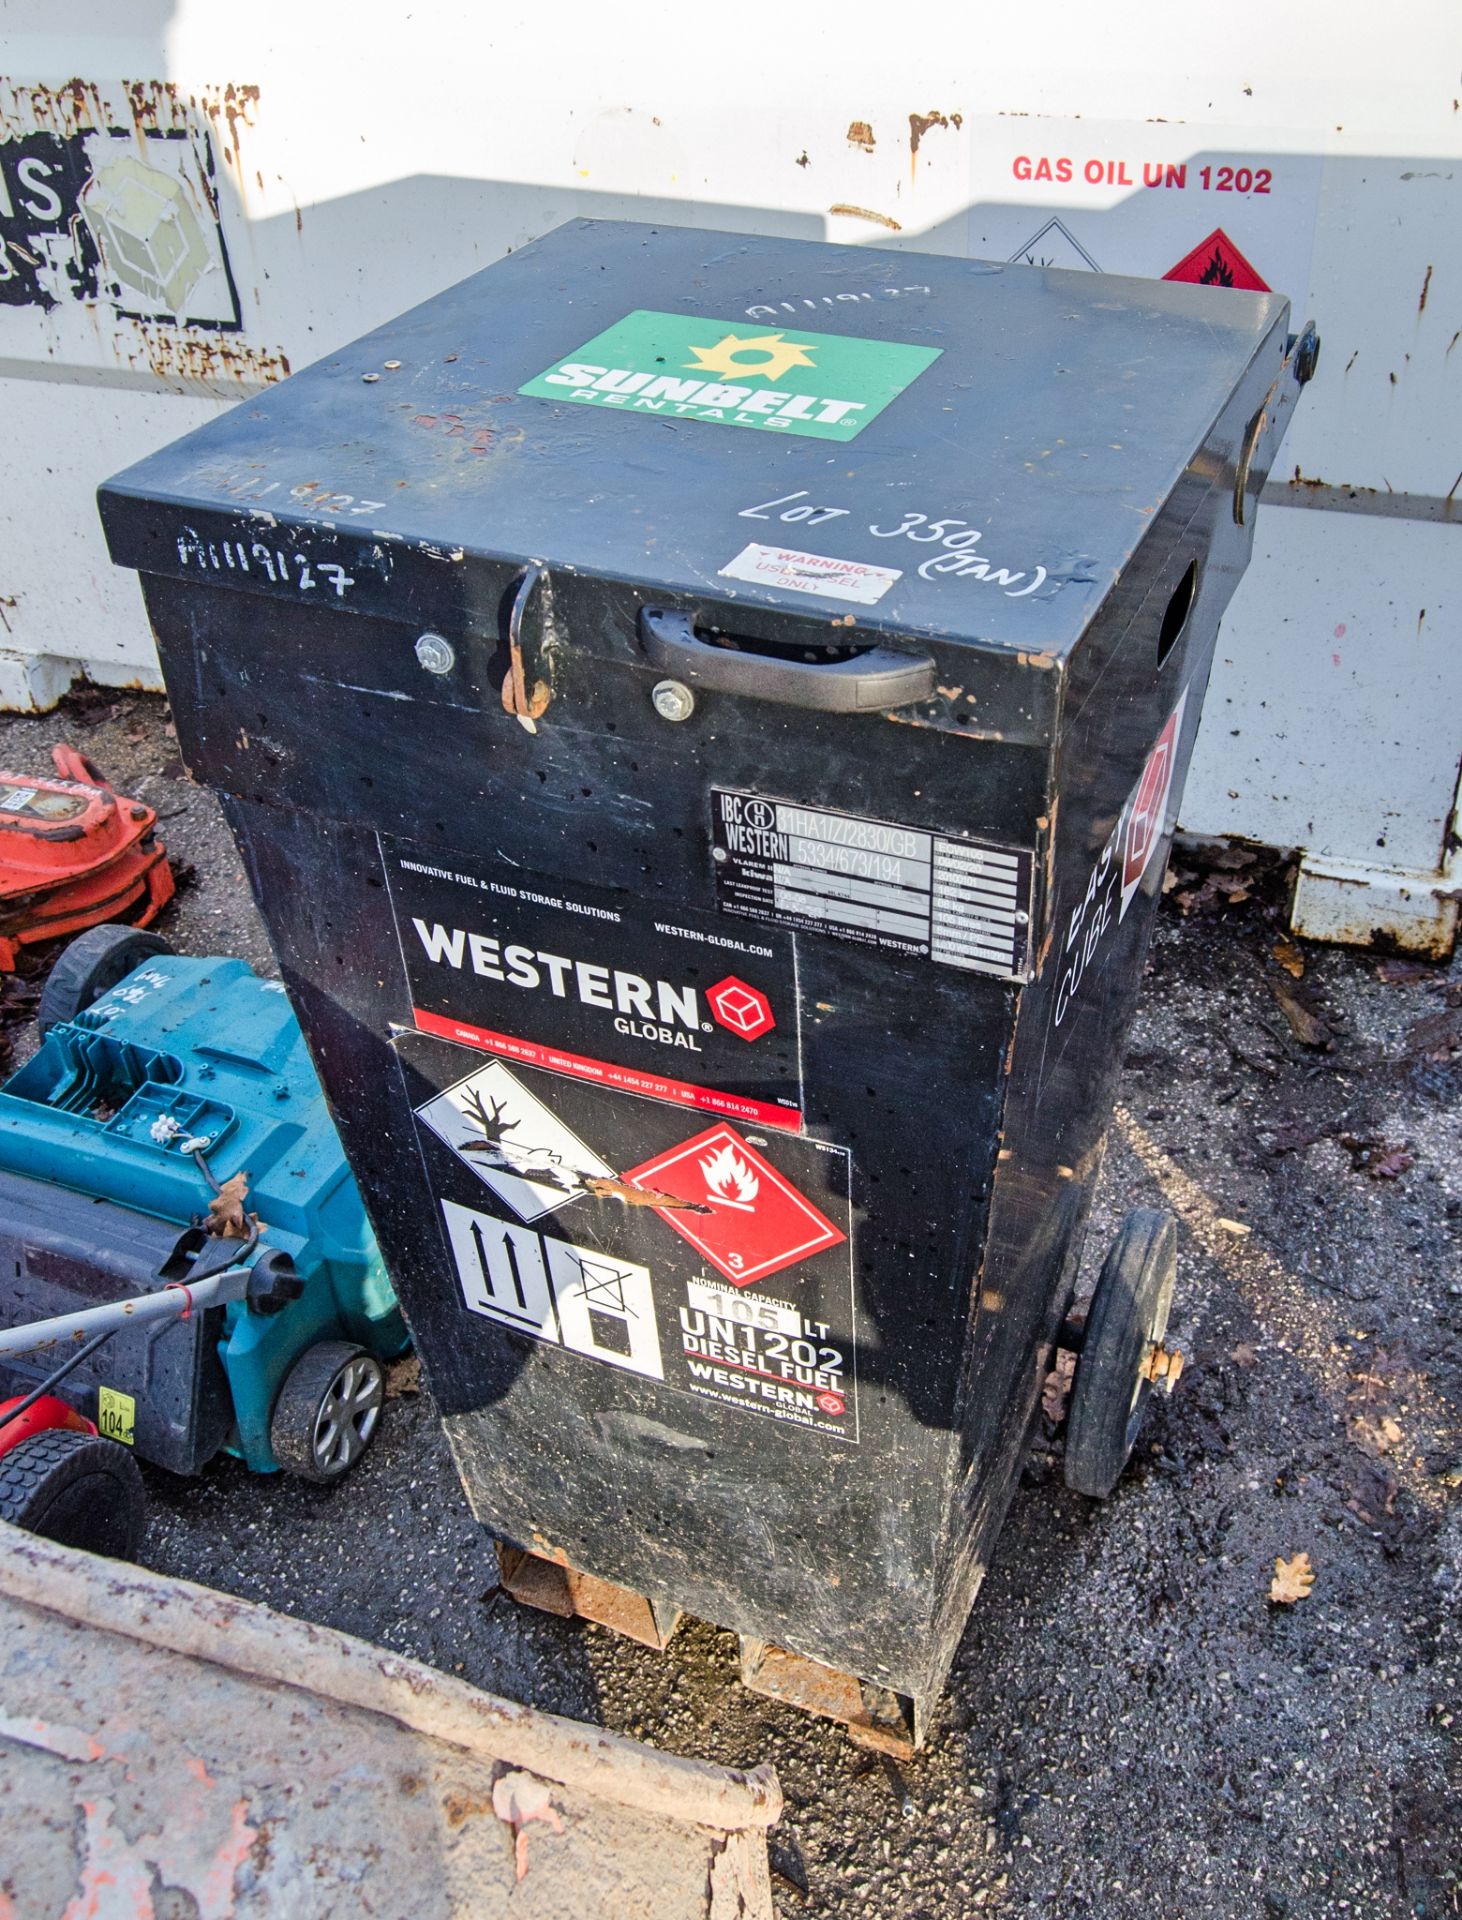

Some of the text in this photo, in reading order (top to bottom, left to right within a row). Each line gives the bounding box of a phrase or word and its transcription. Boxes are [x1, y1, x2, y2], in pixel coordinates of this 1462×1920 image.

[0, 157, 62, 221] S
[1012, 155, 1273, 194] GAS OIL UN 1202
[569, 389, 794, 428] RENTALS
[869, 513, 982, 549] 350
[777, 552, 870, 575] WARNING
[776, 577, 819, 592] ONLY
[721, 794, 742, 824] IBC
[724, 822, 788, 861] WESTERN
[733, 857, 766, 870] VLAREM
[742, 868, 773, 882] kiwa
[400, 860, 621, 922] INNOVATIVE FUEL & FLUID STORAGE SOLUTIONS
[654, 922, 773, 958] WESTERN-GLOBAL.COM
[878, 937, 919, 953] WESTERN
[1054, 872, 1117, 1027] CUBE
[412, 917, 699, 1029] WESTERN
[614, 1017, 702, 1052] GLOBAL
[455, 1029, 480, 1042] CANADA
[549, 1056, 572, 1068] UNITED
[573, 1062, 603, 1076] KINGDOM
[623, 1076, 640, 1087] 1454
[641, 1080, 653, 1089] 227
[655, 1083, 667, 1093] 277
[681, 1090, 695, 1101] USA
[741, 1105, 758, 1115] 2470
[728, 1252, 744, 1270] 3
[692, 1275, 796, 1310] NOMINAL CAPACITY
[707, 1293, 830, 1340] 105 LT
[682, 1333, 845, 1394] DIESEL FUEL
[687, 1360, 814, 1411] WESTERN
[101, 1409, 123, 1437] 104
[689, 1383, 845, 1434] www.western-global.com
[776, 1402, 813, 1417] GLOBAL
